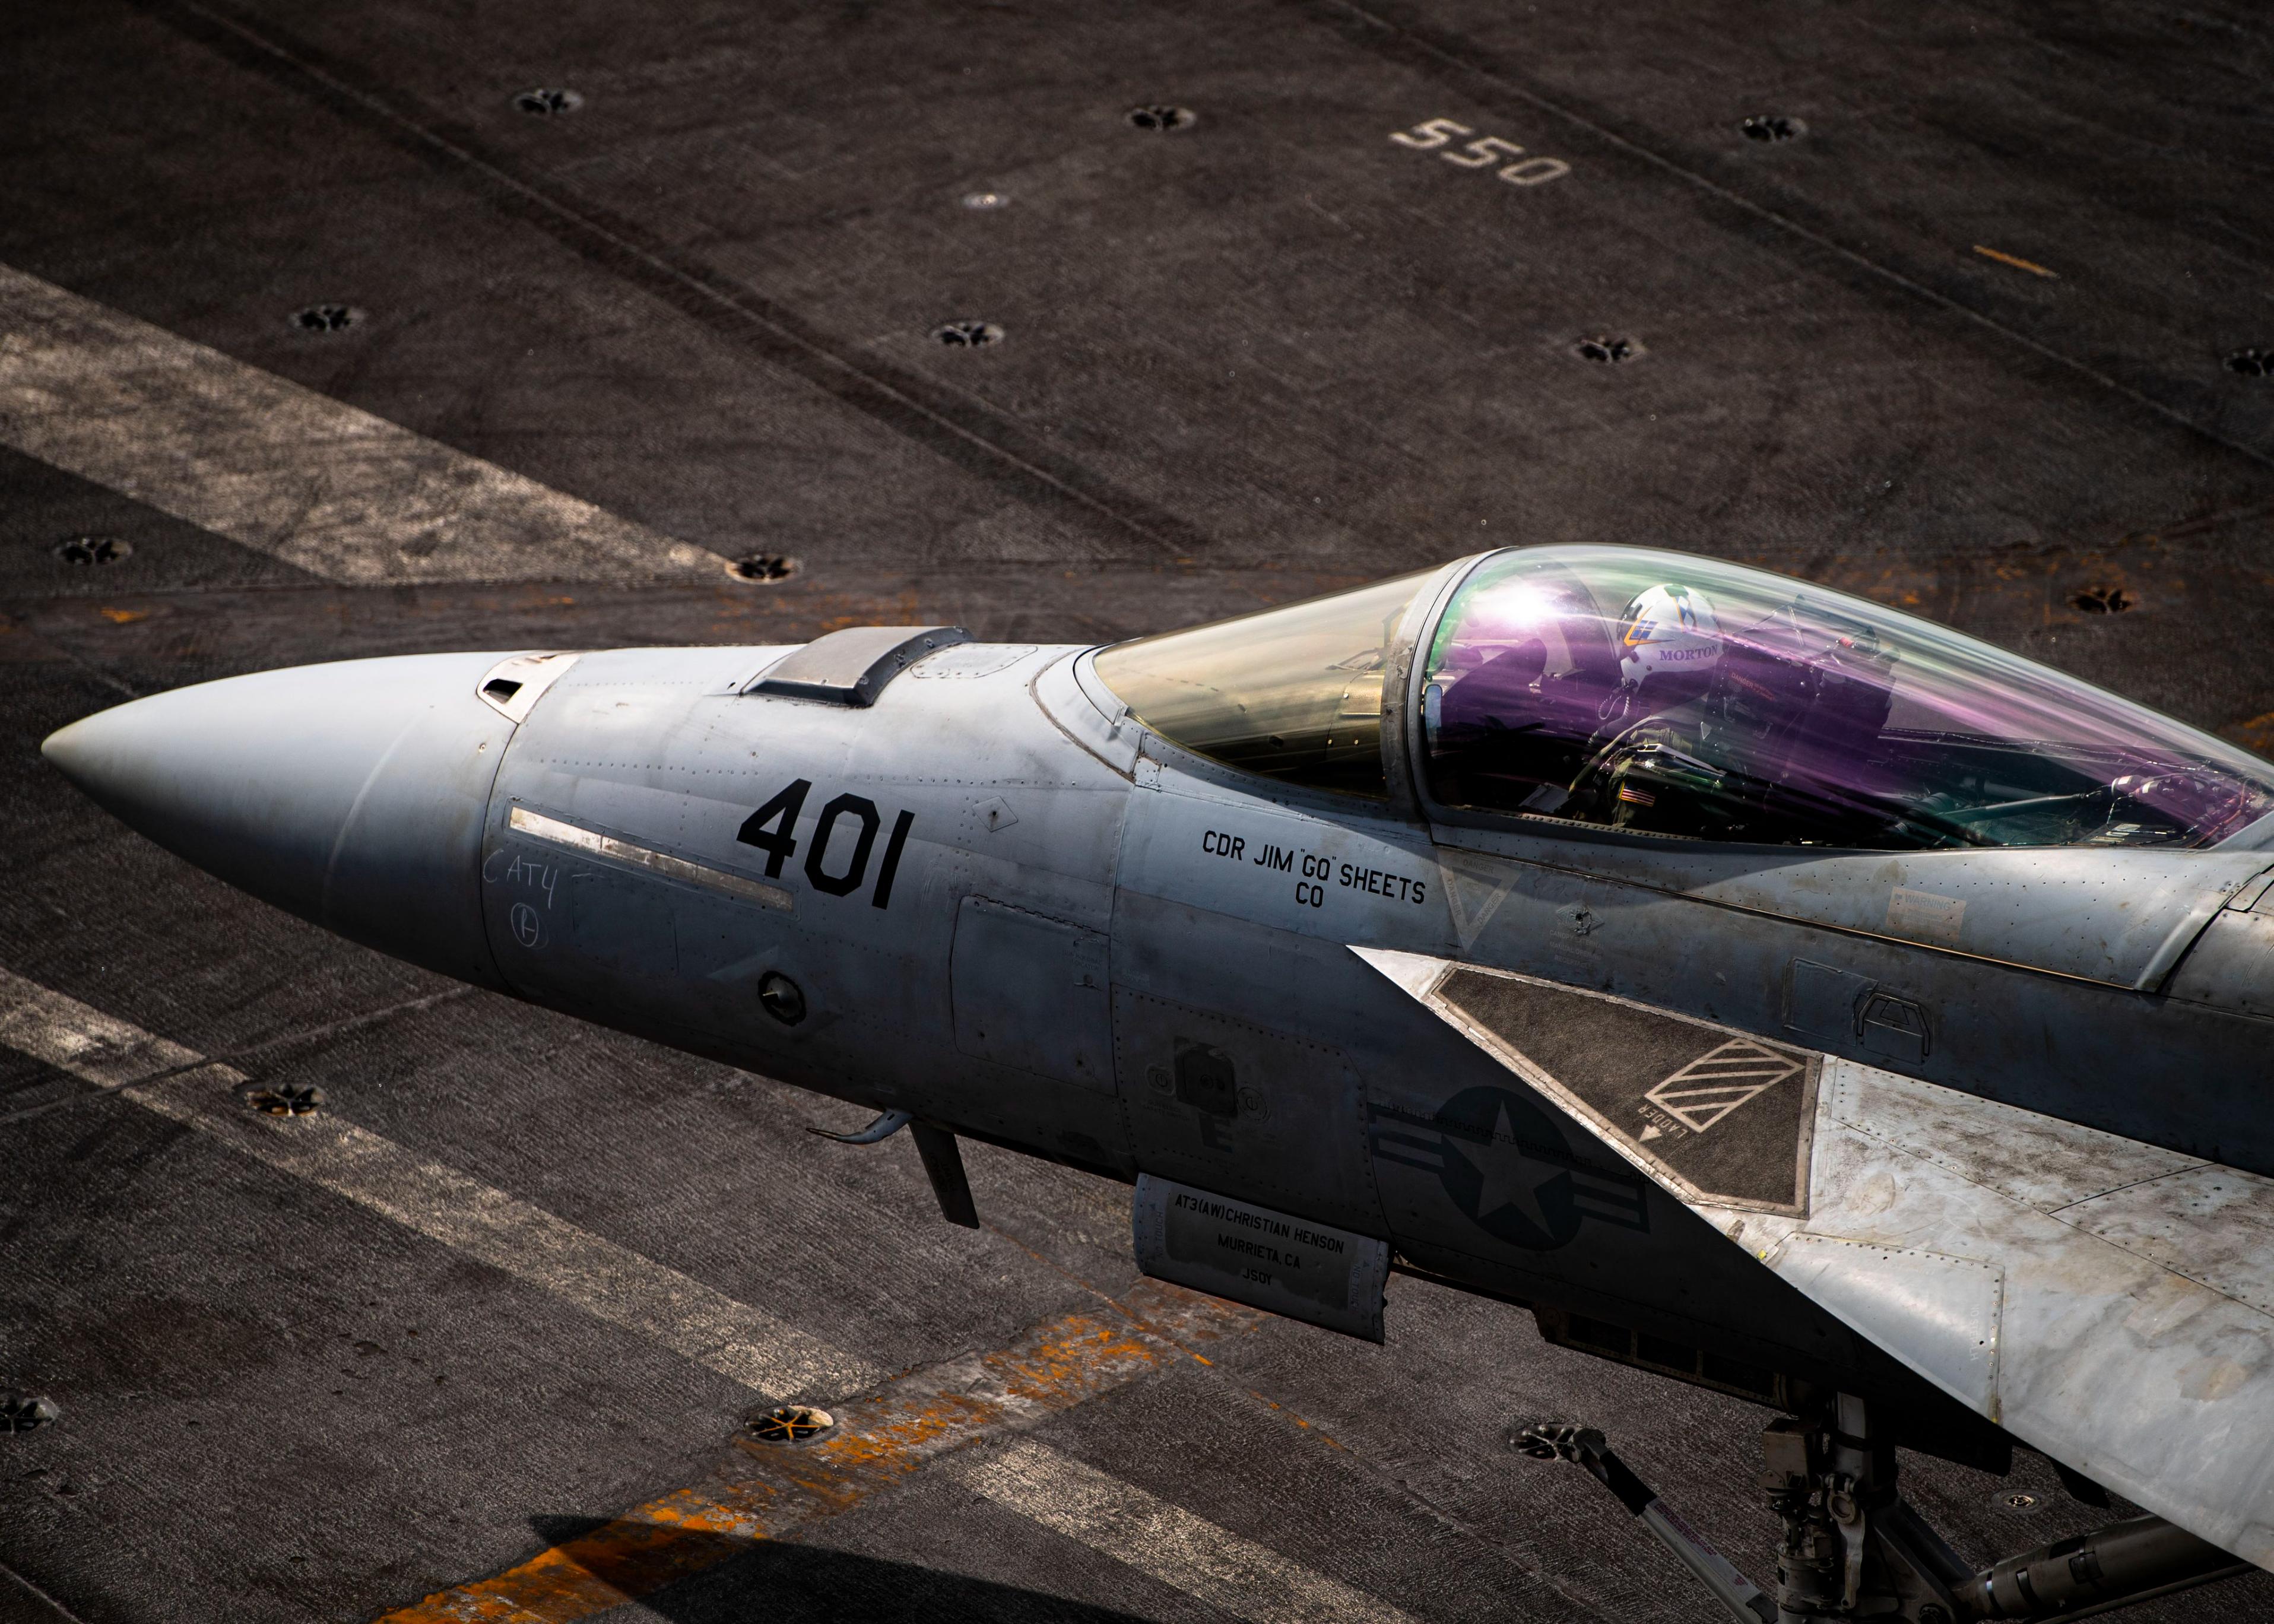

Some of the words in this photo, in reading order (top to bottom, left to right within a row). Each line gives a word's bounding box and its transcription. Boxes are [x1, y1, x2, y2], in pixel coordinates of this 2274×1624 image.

[1388, 118, 1571, 186] 550
[1659, 645, 1718, 661] MORTON
[737, 778, 915, 909] 401
[1203, 830, 1245, 861] CDR
[1254, 844, 1294, 873] JIM
[1339, 864, 1426, 904] SHEETS
[1463, 859, 1495, 874] DANGER
[1296, 882, 1324, 908] CO
[1447, 877, 1461, 917] DANGER
[1477, 892, 1502, 925] DANGER
[1905, 895, 1951, 911] WARNING
[1638, 1103, 1689, 1139] LADDER
[1155, 1211, 1164, 1242] TOUCH
[1294, 1228, 1344, 1254] HENSON
[1285, 1253, 1301, 1269] CA
